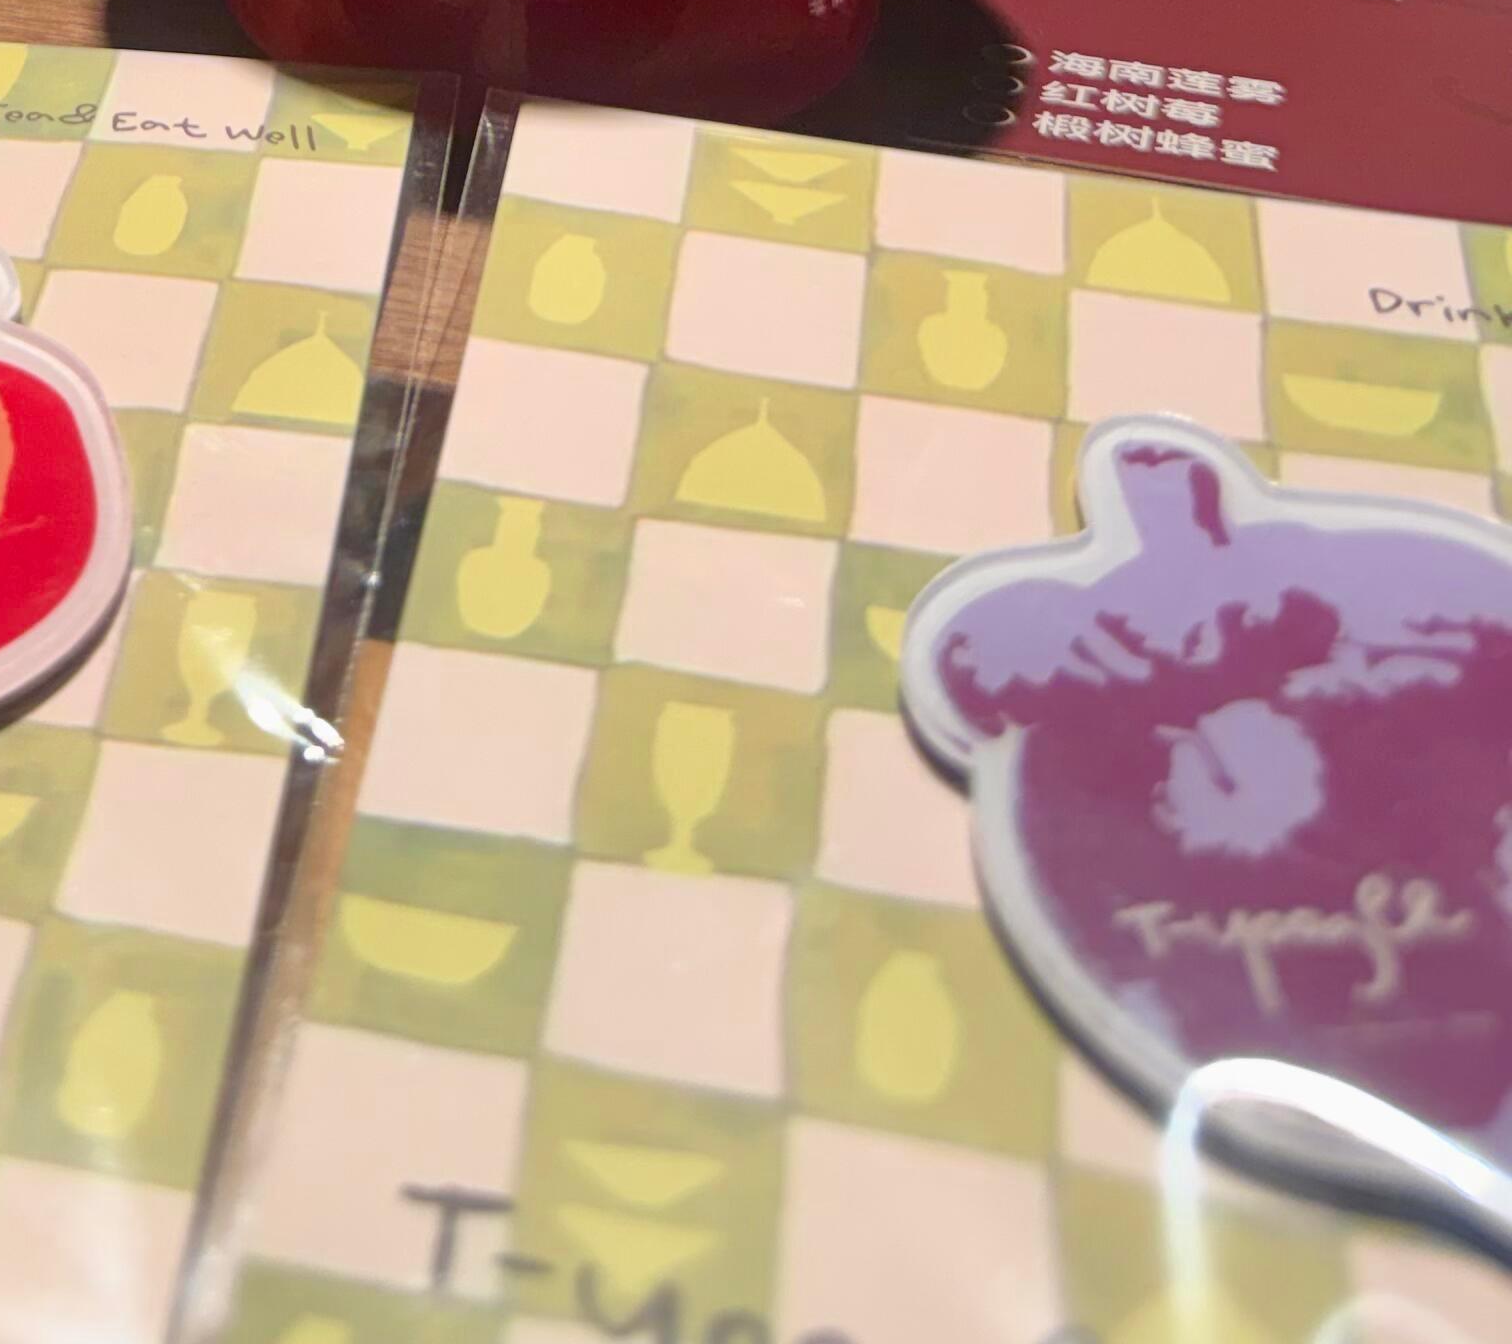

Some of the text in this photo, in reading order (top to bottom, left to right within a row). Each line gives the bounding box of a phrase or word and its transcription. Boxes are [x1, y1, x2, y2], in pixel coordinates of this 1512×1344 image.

[1039, 79, 1223, 128] 红树莓
[1047, 49, 1287, 106] 海南莲雾
[111, 110, 208, 140] Eat
[1031, 110, 1281, 173] 椴树蜂蜜
